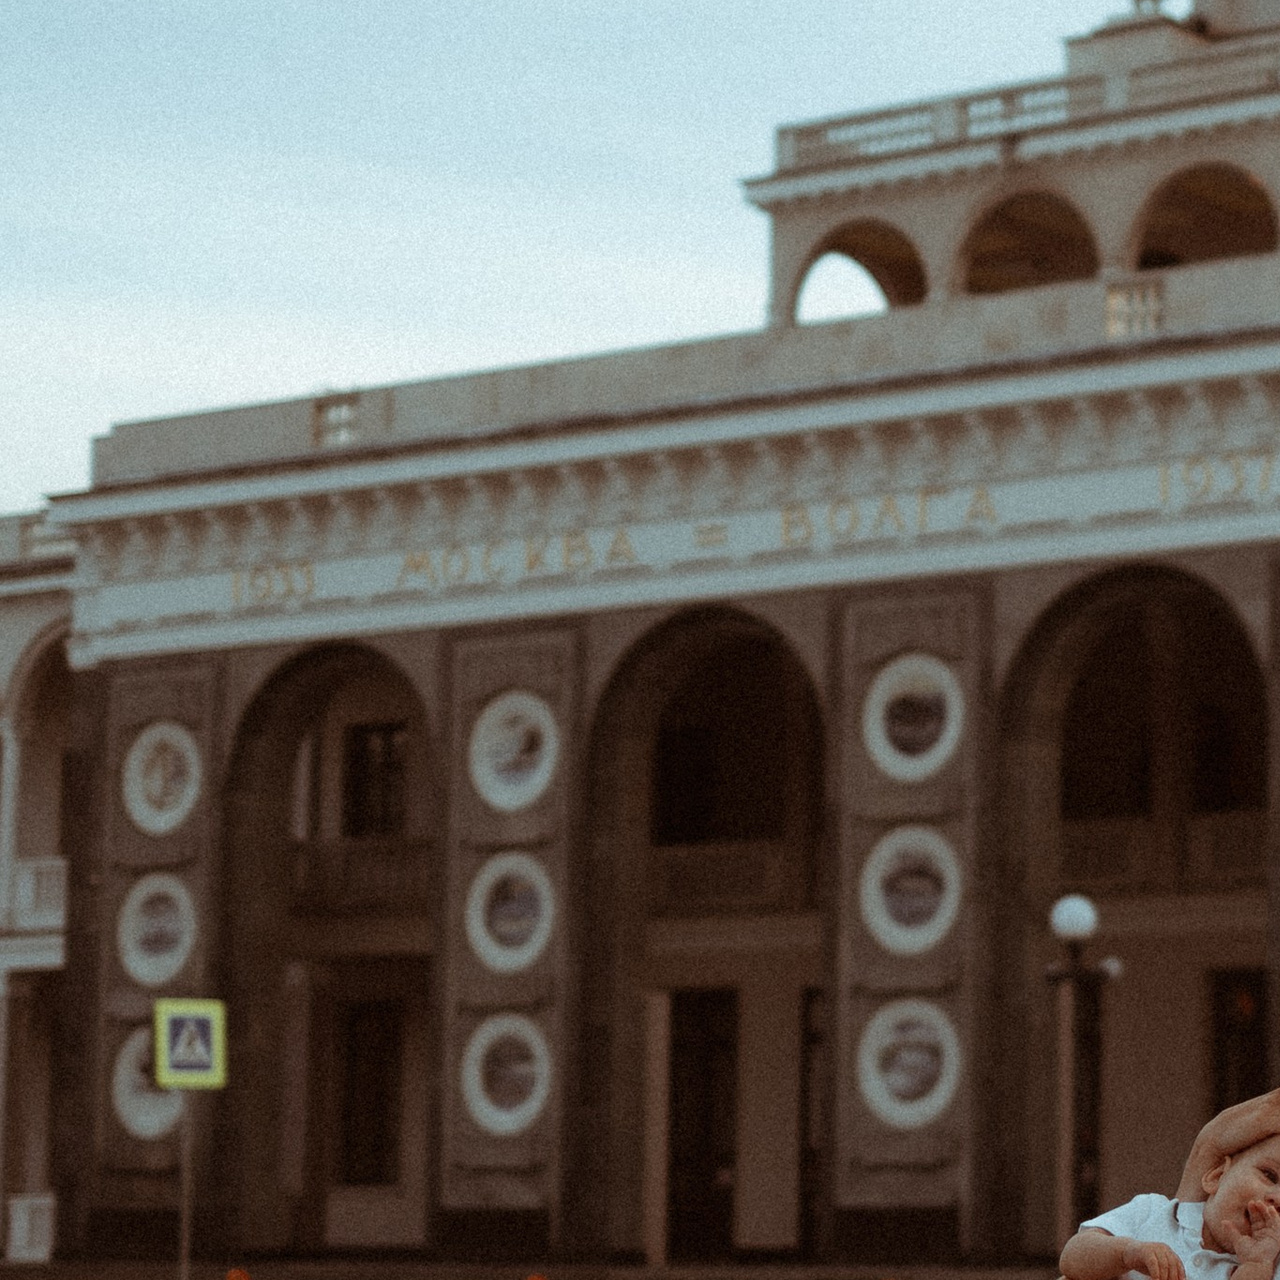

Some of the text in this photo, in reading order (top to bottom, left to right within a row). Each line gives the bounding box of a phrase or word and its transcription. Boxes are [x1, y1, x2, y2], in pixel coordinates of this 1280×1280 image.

[397, 525, 638, 588] МОСКВА
[781, 484, 999, 548] ВОЛГА
[1157, 445, 1276, 504] 1937
